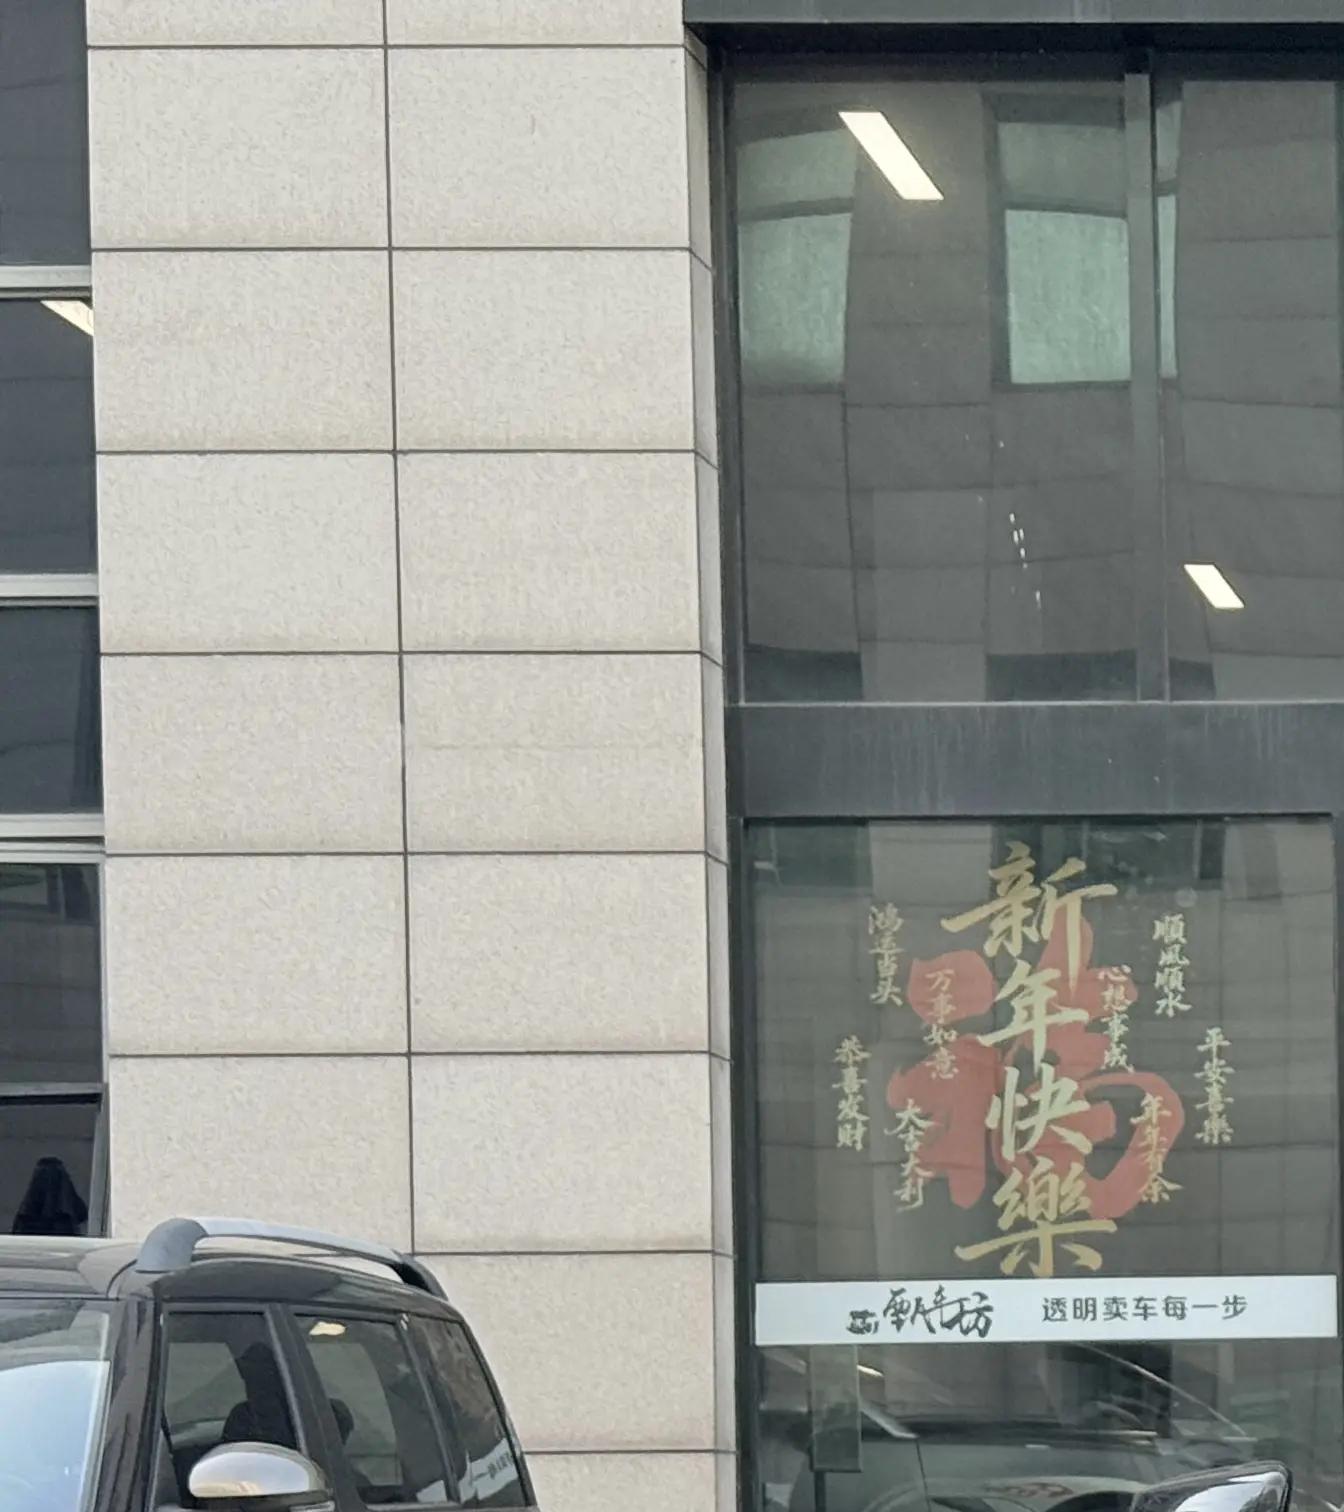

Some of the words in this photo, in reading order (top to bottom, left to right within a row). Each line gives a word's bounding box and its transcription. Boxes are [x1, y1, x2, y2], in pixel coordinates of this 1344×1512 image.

[941, 841, 1118, 1277] 新年快樂
[1042, 1294, 1249, 1323] 透明卖车每一步
